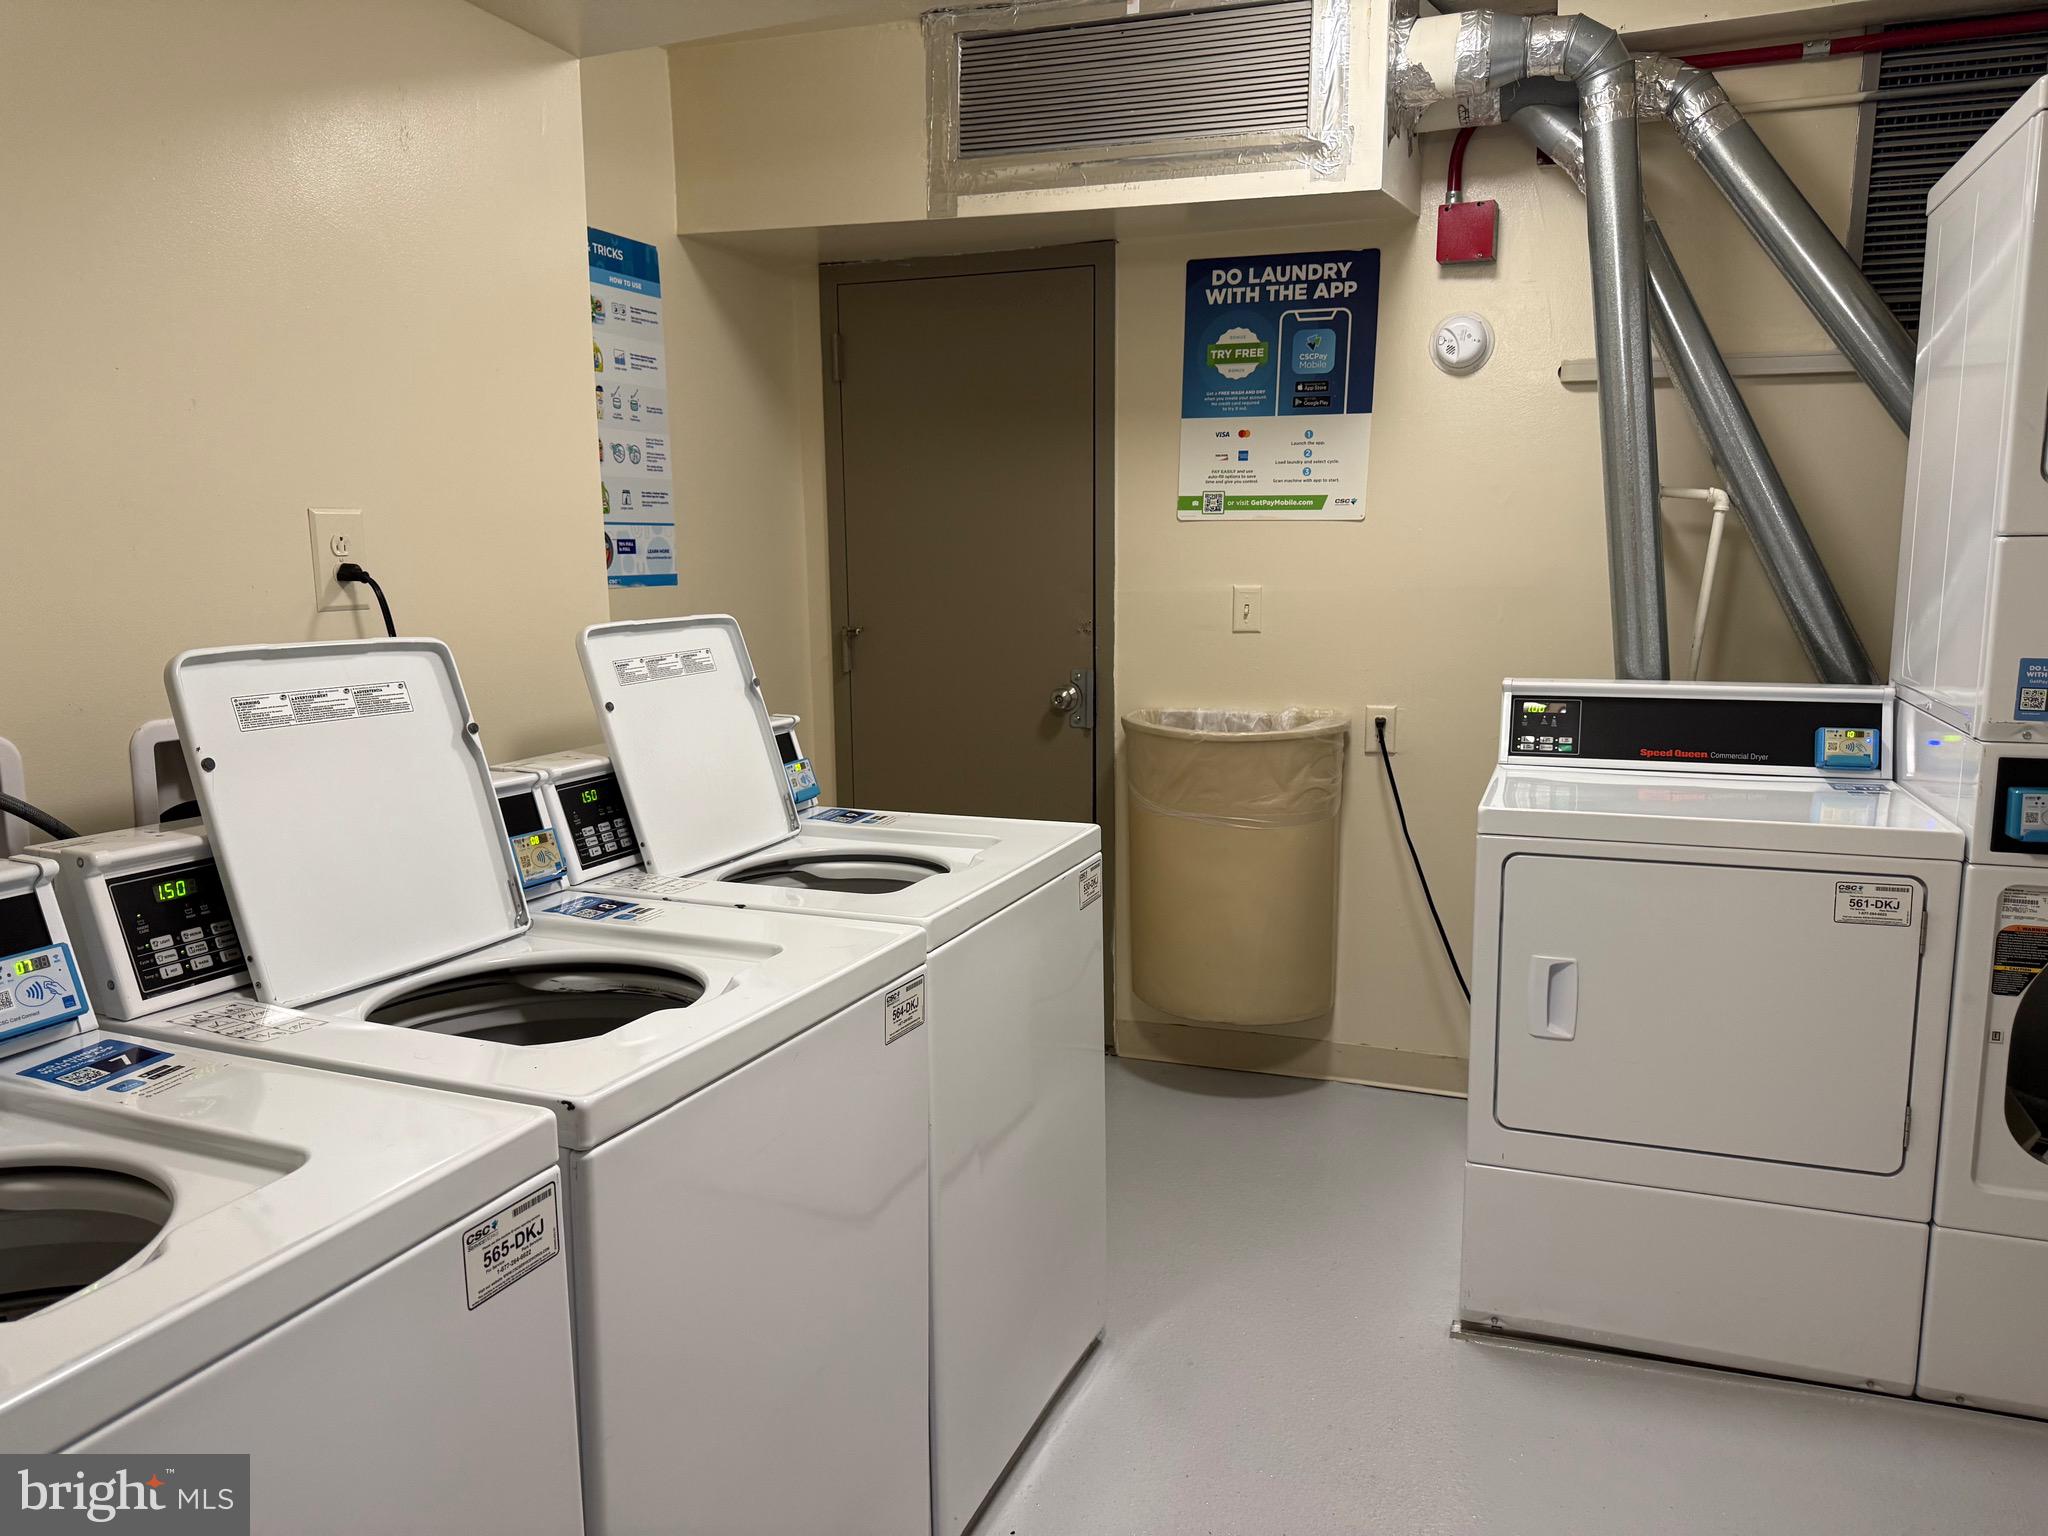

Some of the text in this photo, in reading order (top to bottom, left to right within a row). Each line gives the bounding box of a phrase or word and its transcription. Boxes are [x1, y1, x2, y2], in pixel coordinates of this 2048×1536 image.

[592, 242, 624, 261] TRICKS
[1212, 262, 1353, 286] DO LAUNDRY
[609, 276, 623, 285] HOW
[632, 281, 642, 290] USE
[1205, 281, 1358, 305] WITH THE APP
[1211, 348, 1264, 360] TRY FREE
[1299, 353, 1328, 361] CSCPay
[1299, 361, 1327, 369] Mobile
[1250, 498, 1314, 508] GetPayMobile.com
[1640, 748, 1769, 762] Speed Queen Commercial Dryer
[529, 835, 540, 846] 08
[1838, 883, 1858, 891] CSC
[1848, 898, 1900, 910] 561-DKJ
[15, 959, 33, 975] 07
[892, 997, 919, 1021] 564-DKJ
[108, 1054, 132, 1066] 7
[467, 1225, 491, 1246] CSC
[483, 1218, 544, 1269] 565-DKJ
